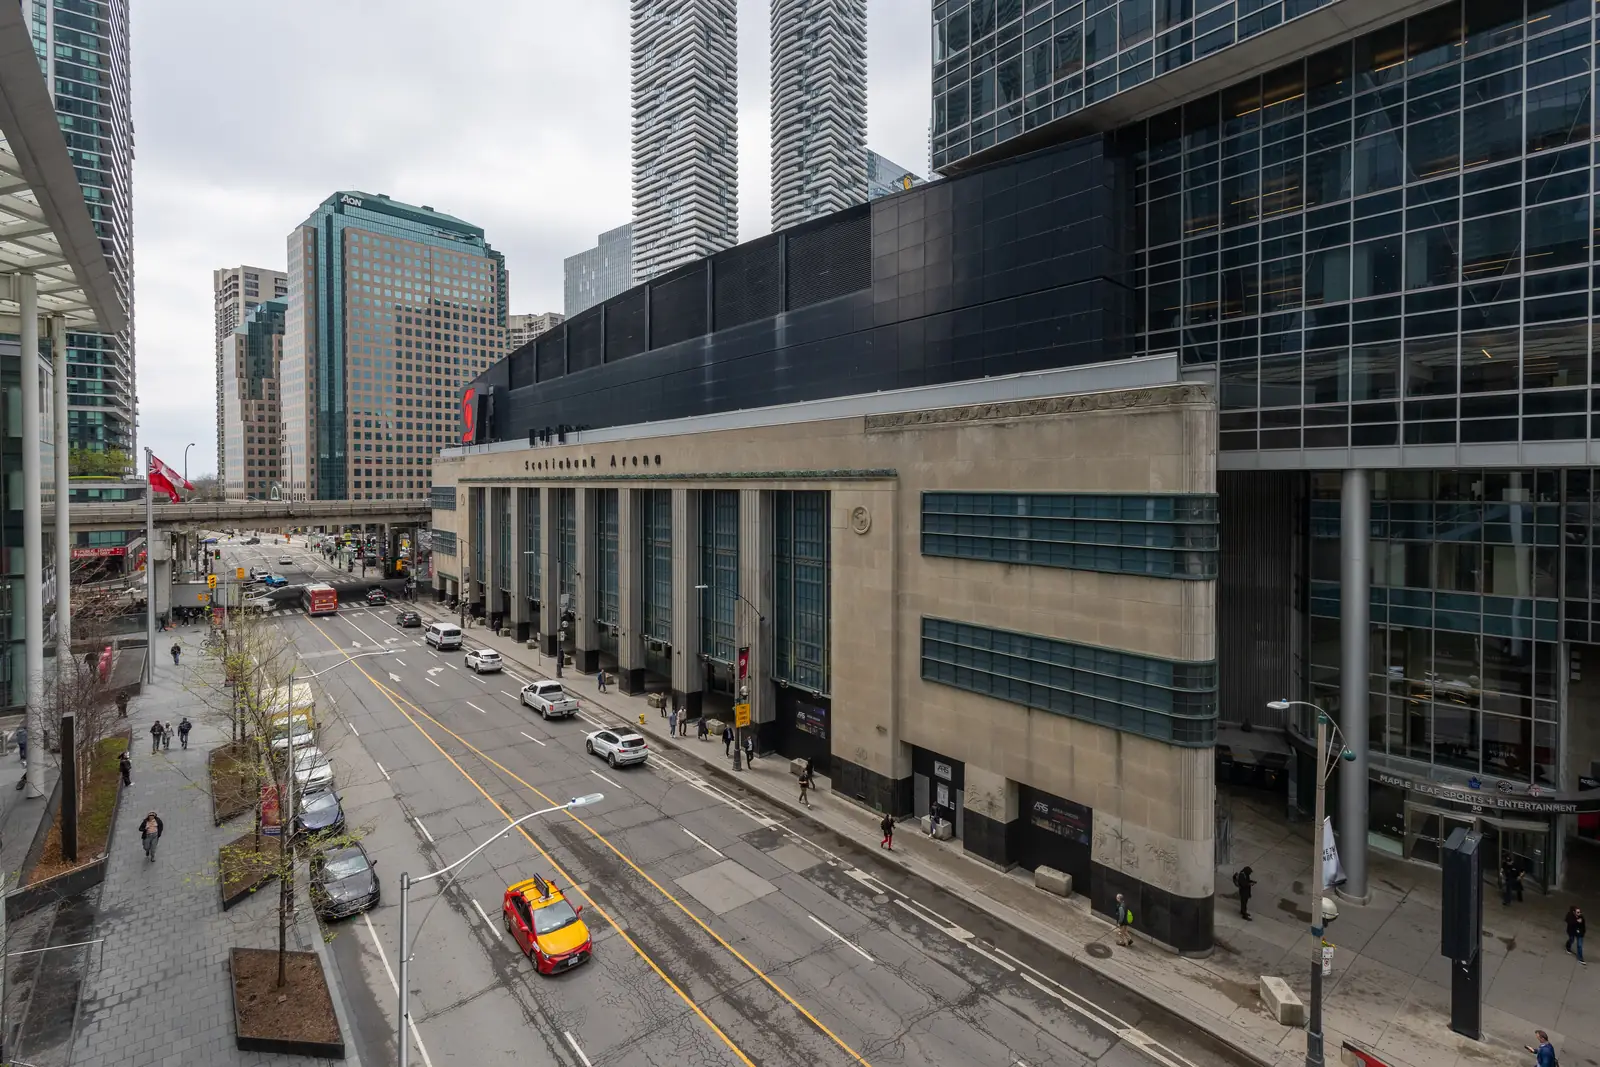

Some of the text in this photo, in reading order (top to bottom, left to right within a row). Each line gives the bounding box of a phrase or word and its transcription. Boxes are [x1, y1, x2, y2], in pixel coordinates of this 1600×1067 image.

[525, 454, 662, 470] Scotiabank Arena
[1380, 774, 1412, 789] MAPLE
[1414, 783, 1441, 796] LEAF
[1443, 790, 1484, 804] SPORTS
[1497, 799, 1578, 812] ENTERTAINMENT
